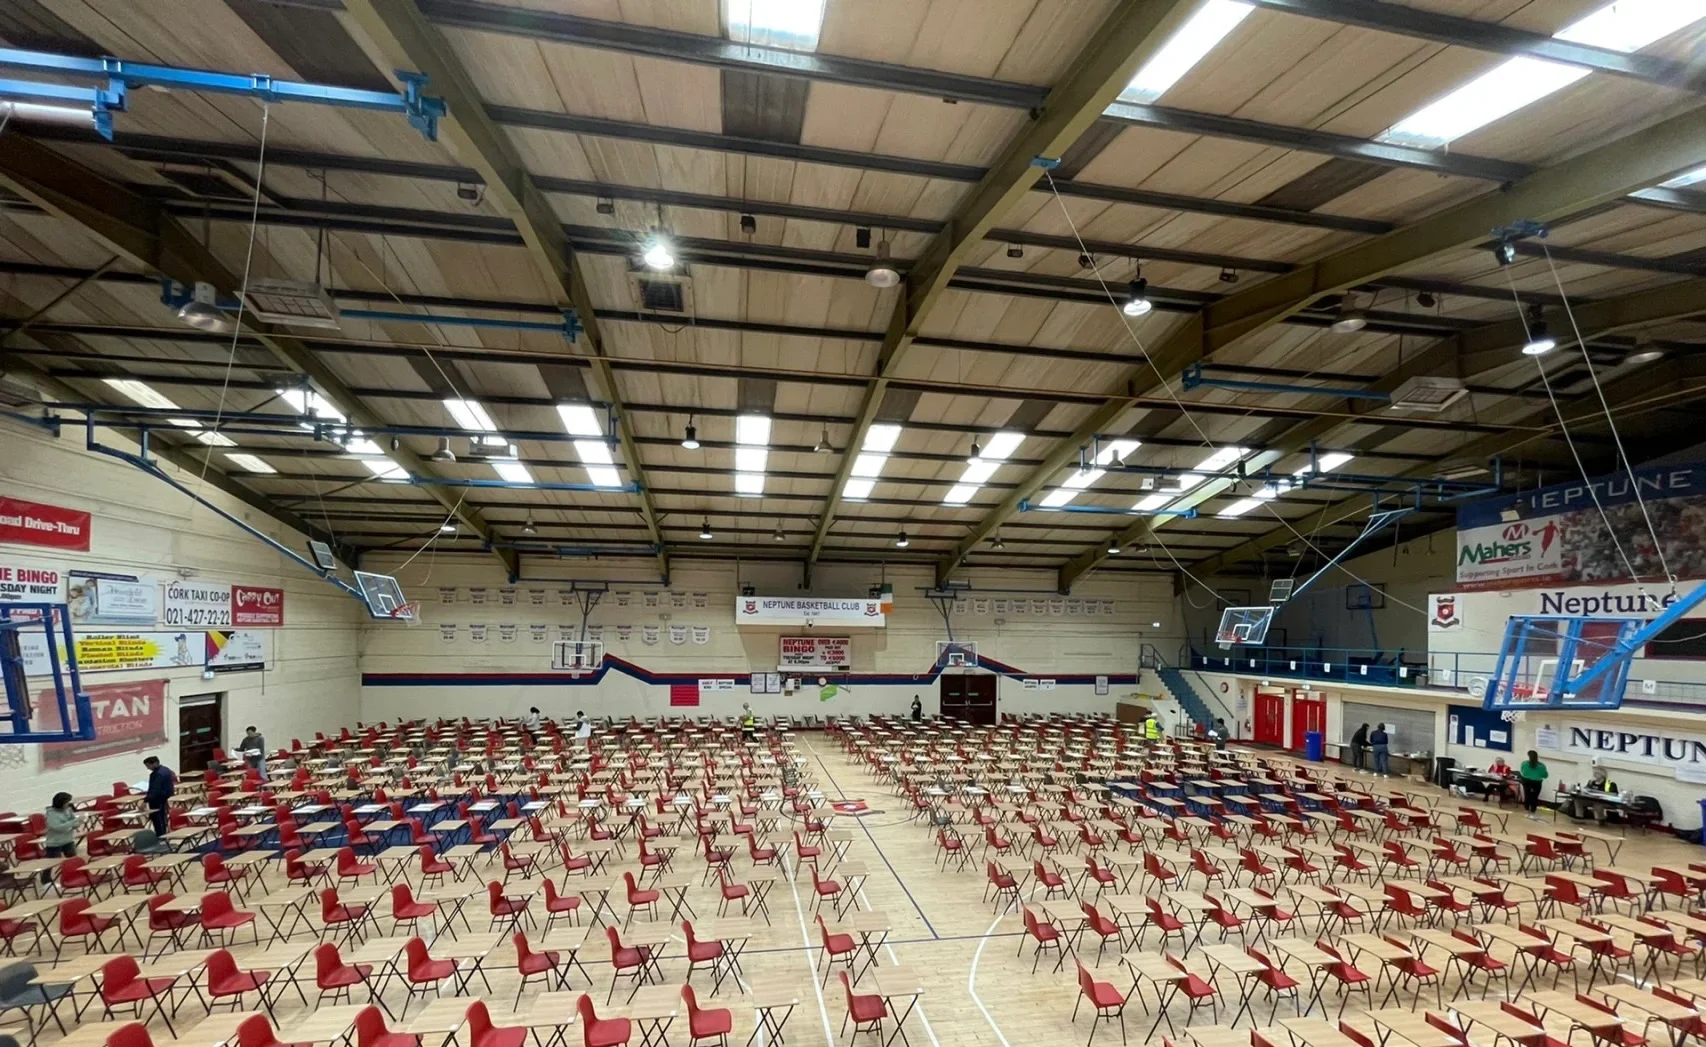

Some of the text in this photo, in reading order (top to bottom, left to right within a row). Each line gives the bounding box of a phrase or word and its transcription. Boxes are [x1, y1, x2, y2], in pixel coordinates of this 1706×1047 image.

[25, 517, 80, 535] Drive-Thru
[1458, 541, 1531, 566] Mahers
[17, 569, 58, 585] BINGO
[1502, 566, 1523, 575] Sport
[30, 585, 58, 595] NIGHT
[168, 588, 230, 602] CORK TAXI CO-OP
[763, 600, 860, 611] NEPTUNE BASKETBALL CLUB
[1540, 591, 1679, 617] Neptune
[166, 608, 230, 625] 021-427-22-22
[1569, 726, 1706, 763] NEPTUN
